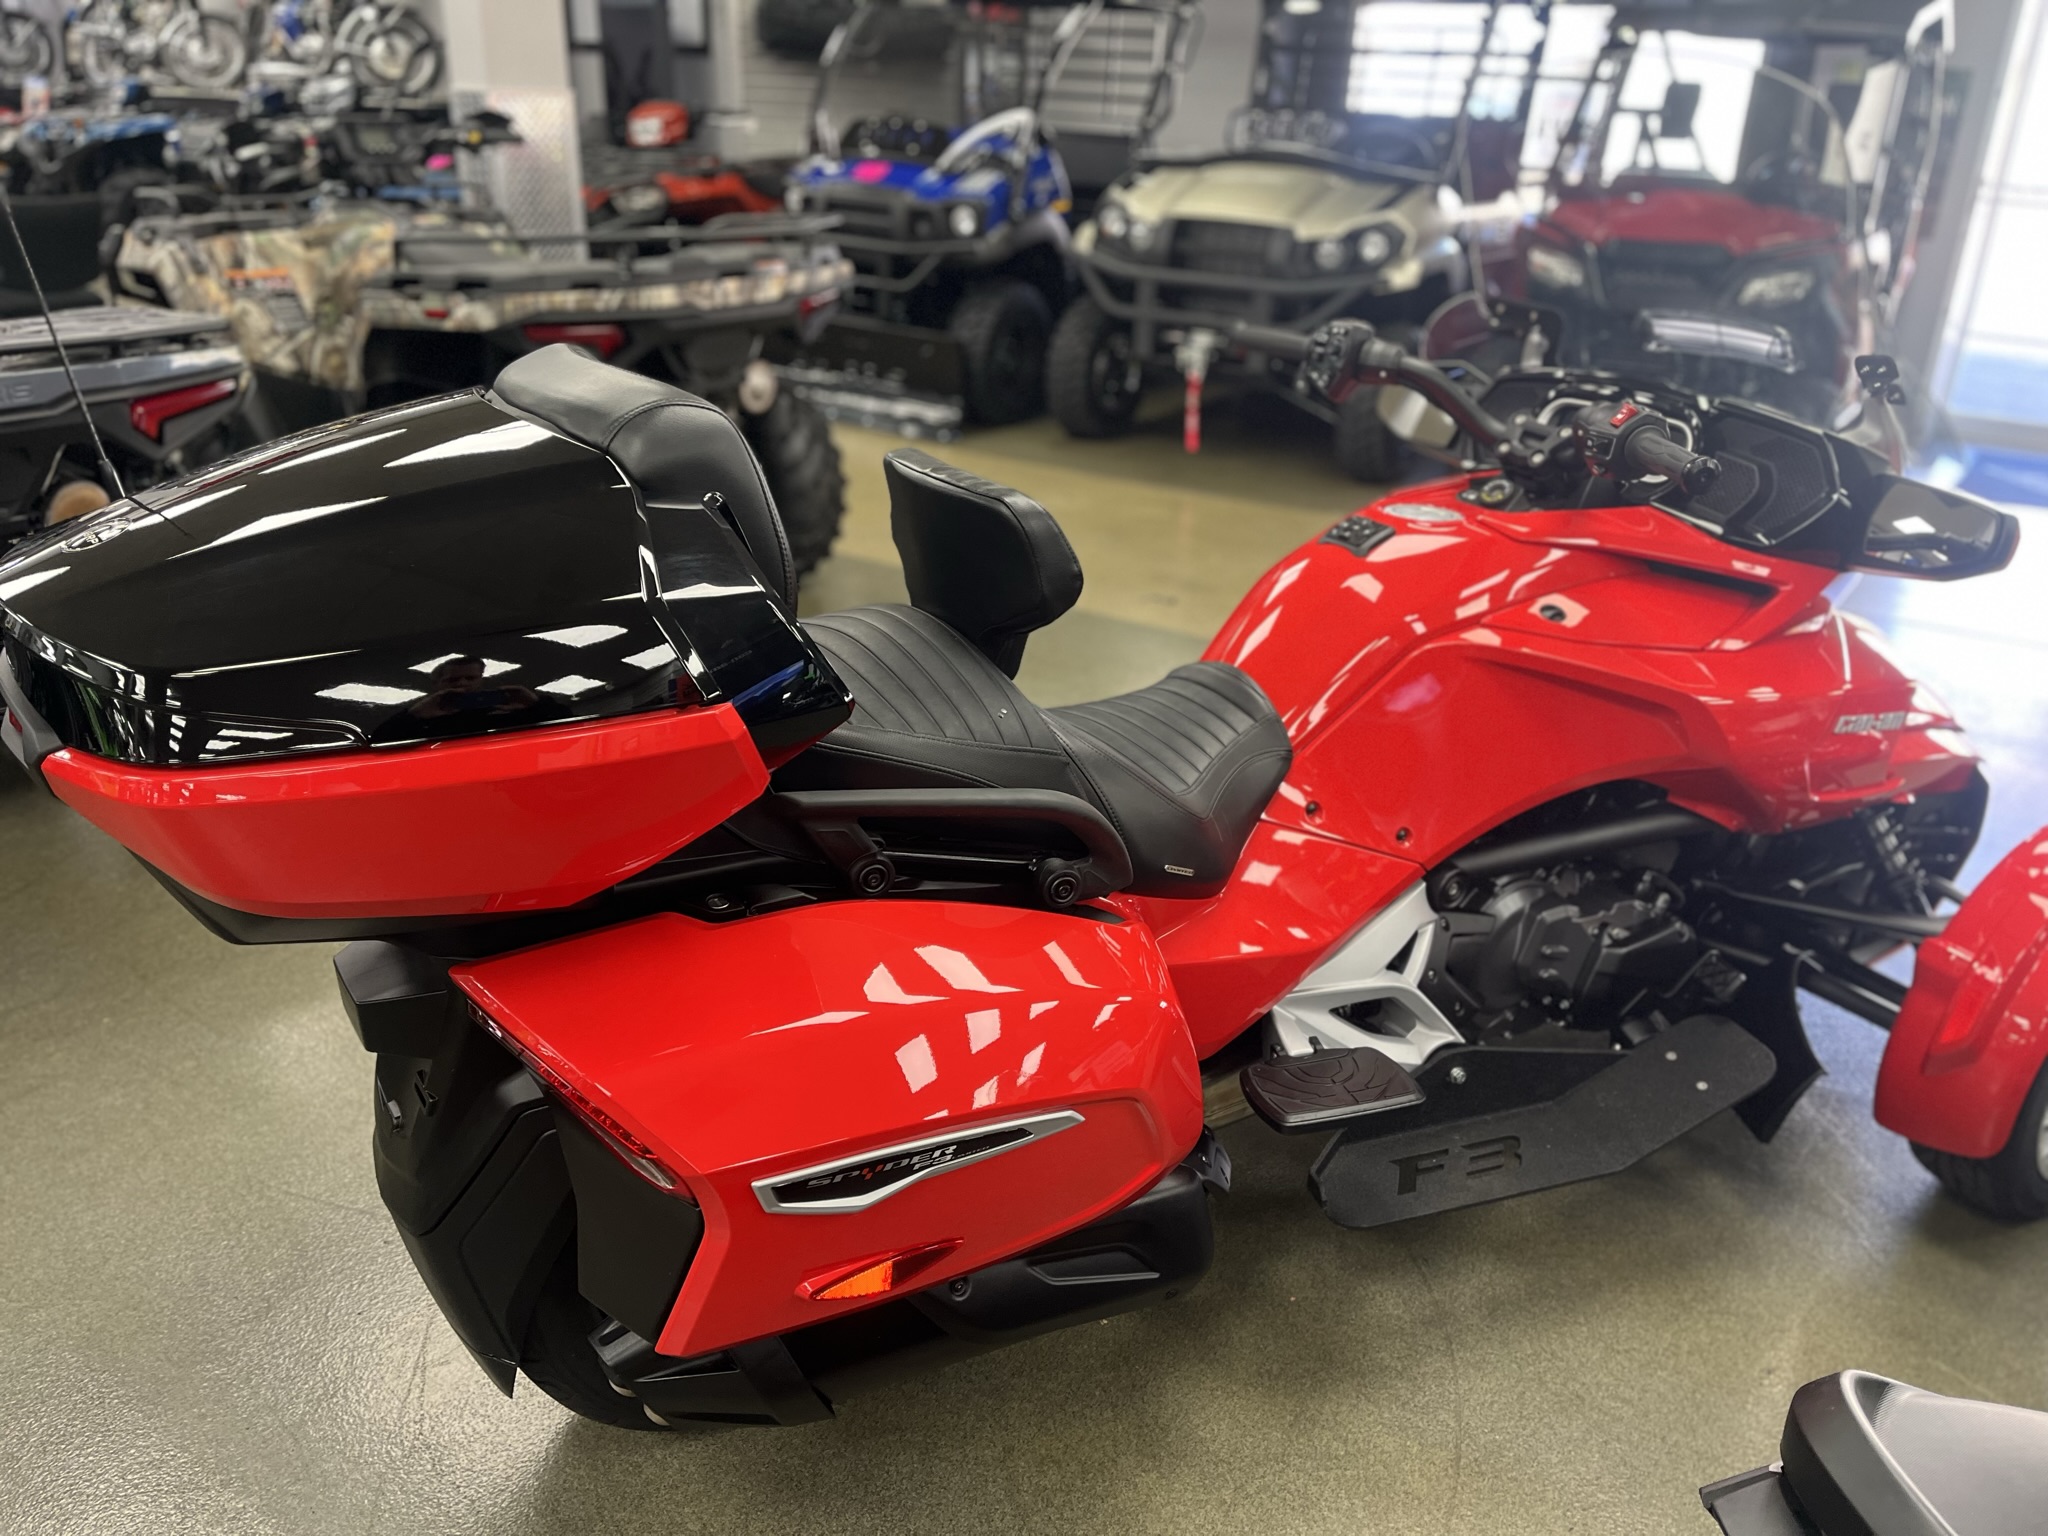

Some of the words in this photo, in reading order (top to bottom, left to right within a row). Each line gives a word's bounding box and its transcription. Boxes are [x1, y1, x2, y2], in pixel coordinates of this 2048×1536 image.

[806, 1145, 957, 1188] SPYDER
[913, 1154, 953, 1171] F3
[1388, 1135, 1522, 1196] F3
